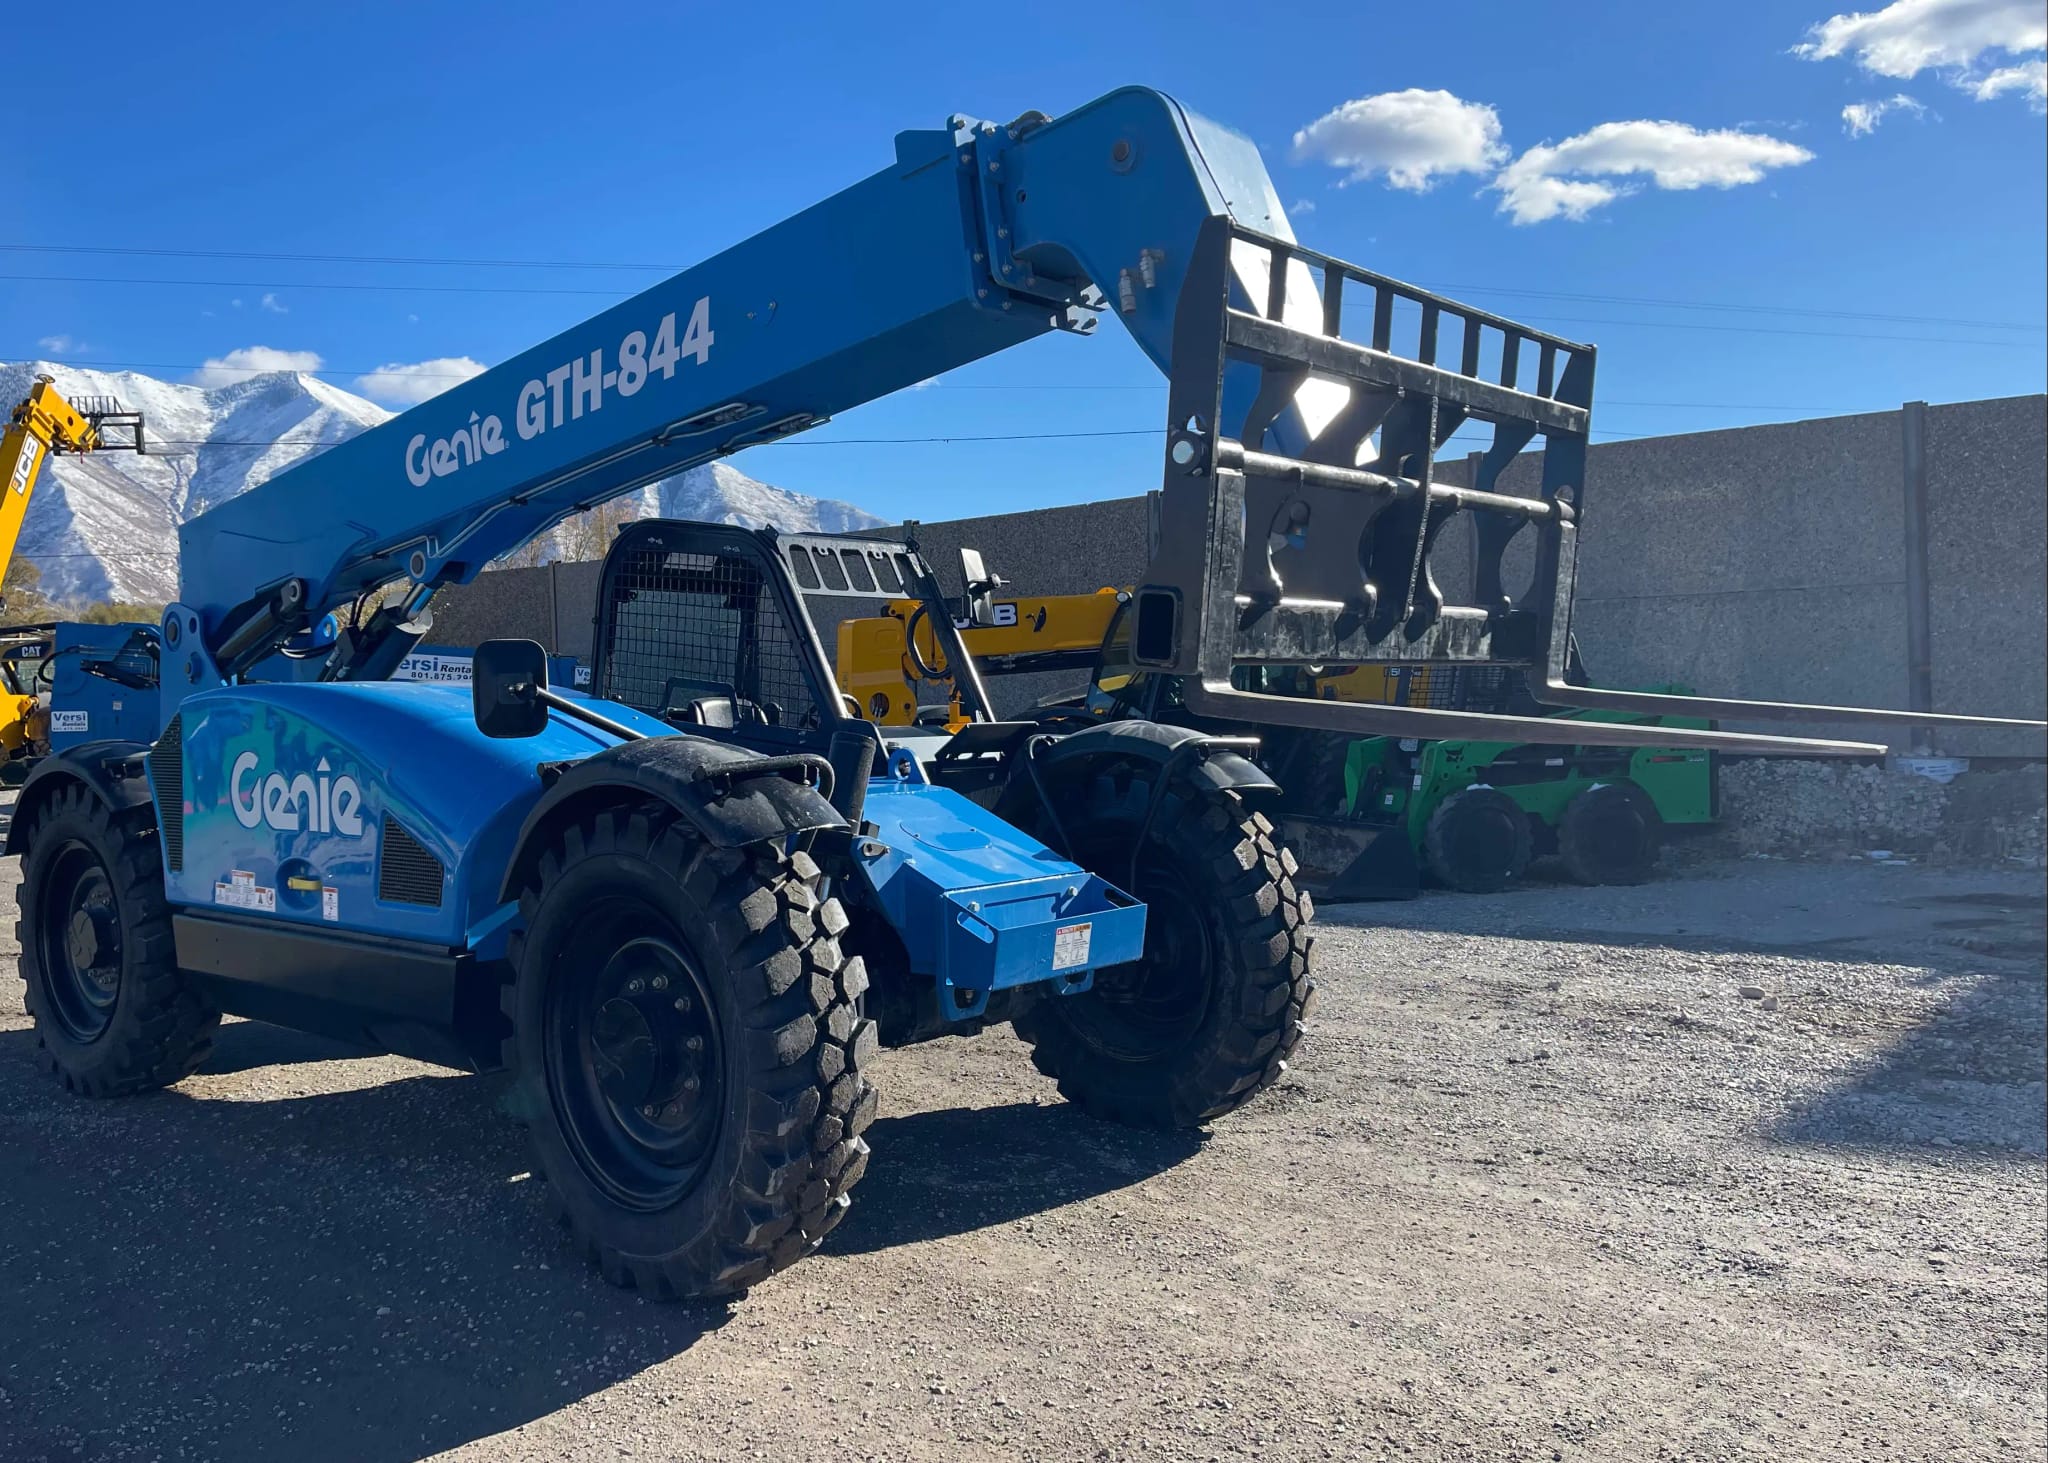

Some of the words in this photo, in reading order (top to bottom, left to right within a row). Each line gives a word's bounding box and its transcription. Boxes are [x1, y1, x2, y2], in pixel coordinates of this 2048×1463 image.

[405, 410, 505, 487] Genie
[516, 296, 715, 440] GTH-844
[14, 435, 39, 495] JCB
[21, 646, 41, 657] CAT
[399, 657, 439, 672] ersi
[440, 664, 474, 674] Renta
[53, 712, 86, 722] Versi
[231, 751, 362, 836] Genie
